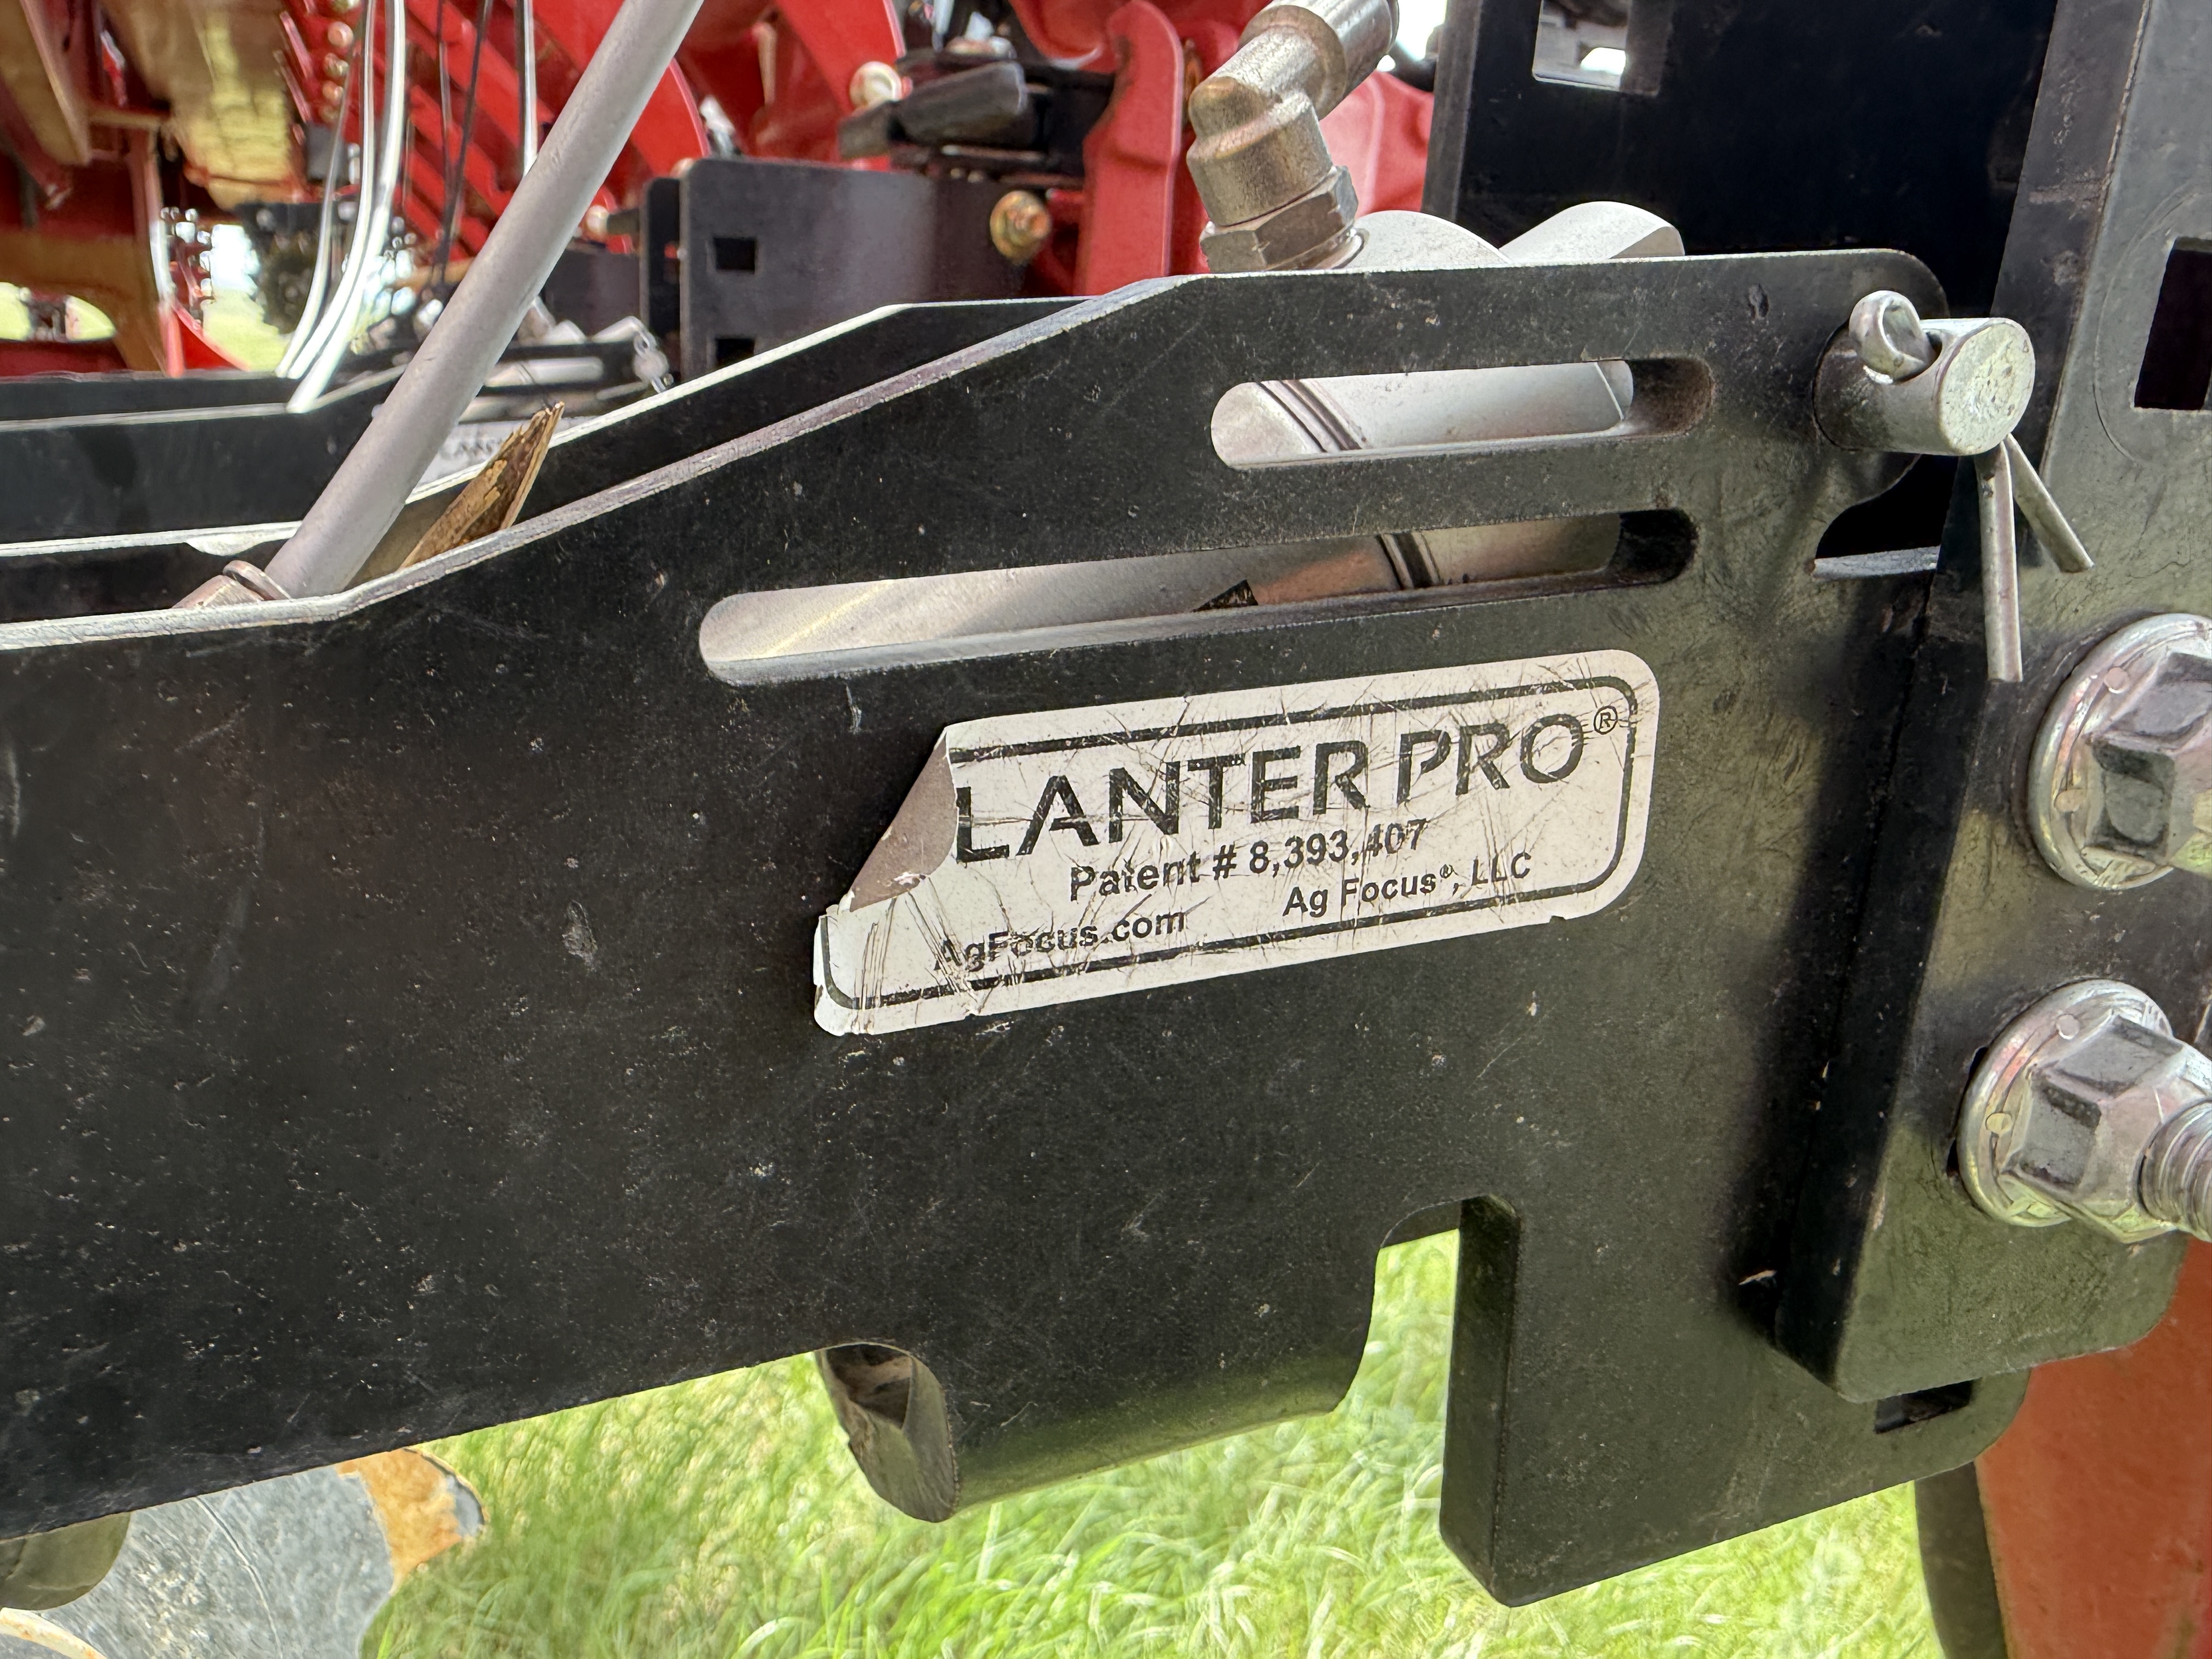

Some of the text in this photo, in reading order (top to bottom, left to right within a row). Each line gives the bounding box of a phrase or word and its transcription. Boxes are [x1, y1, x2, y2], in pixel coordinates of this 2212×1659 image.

[956, 740, 1369, 864] LANTER
[1070, 818, 1427, 902] Patent # 8,393,407
[1282, 886, 1329, 918] Ag
[1471, 851, 1532, 886] LLC
